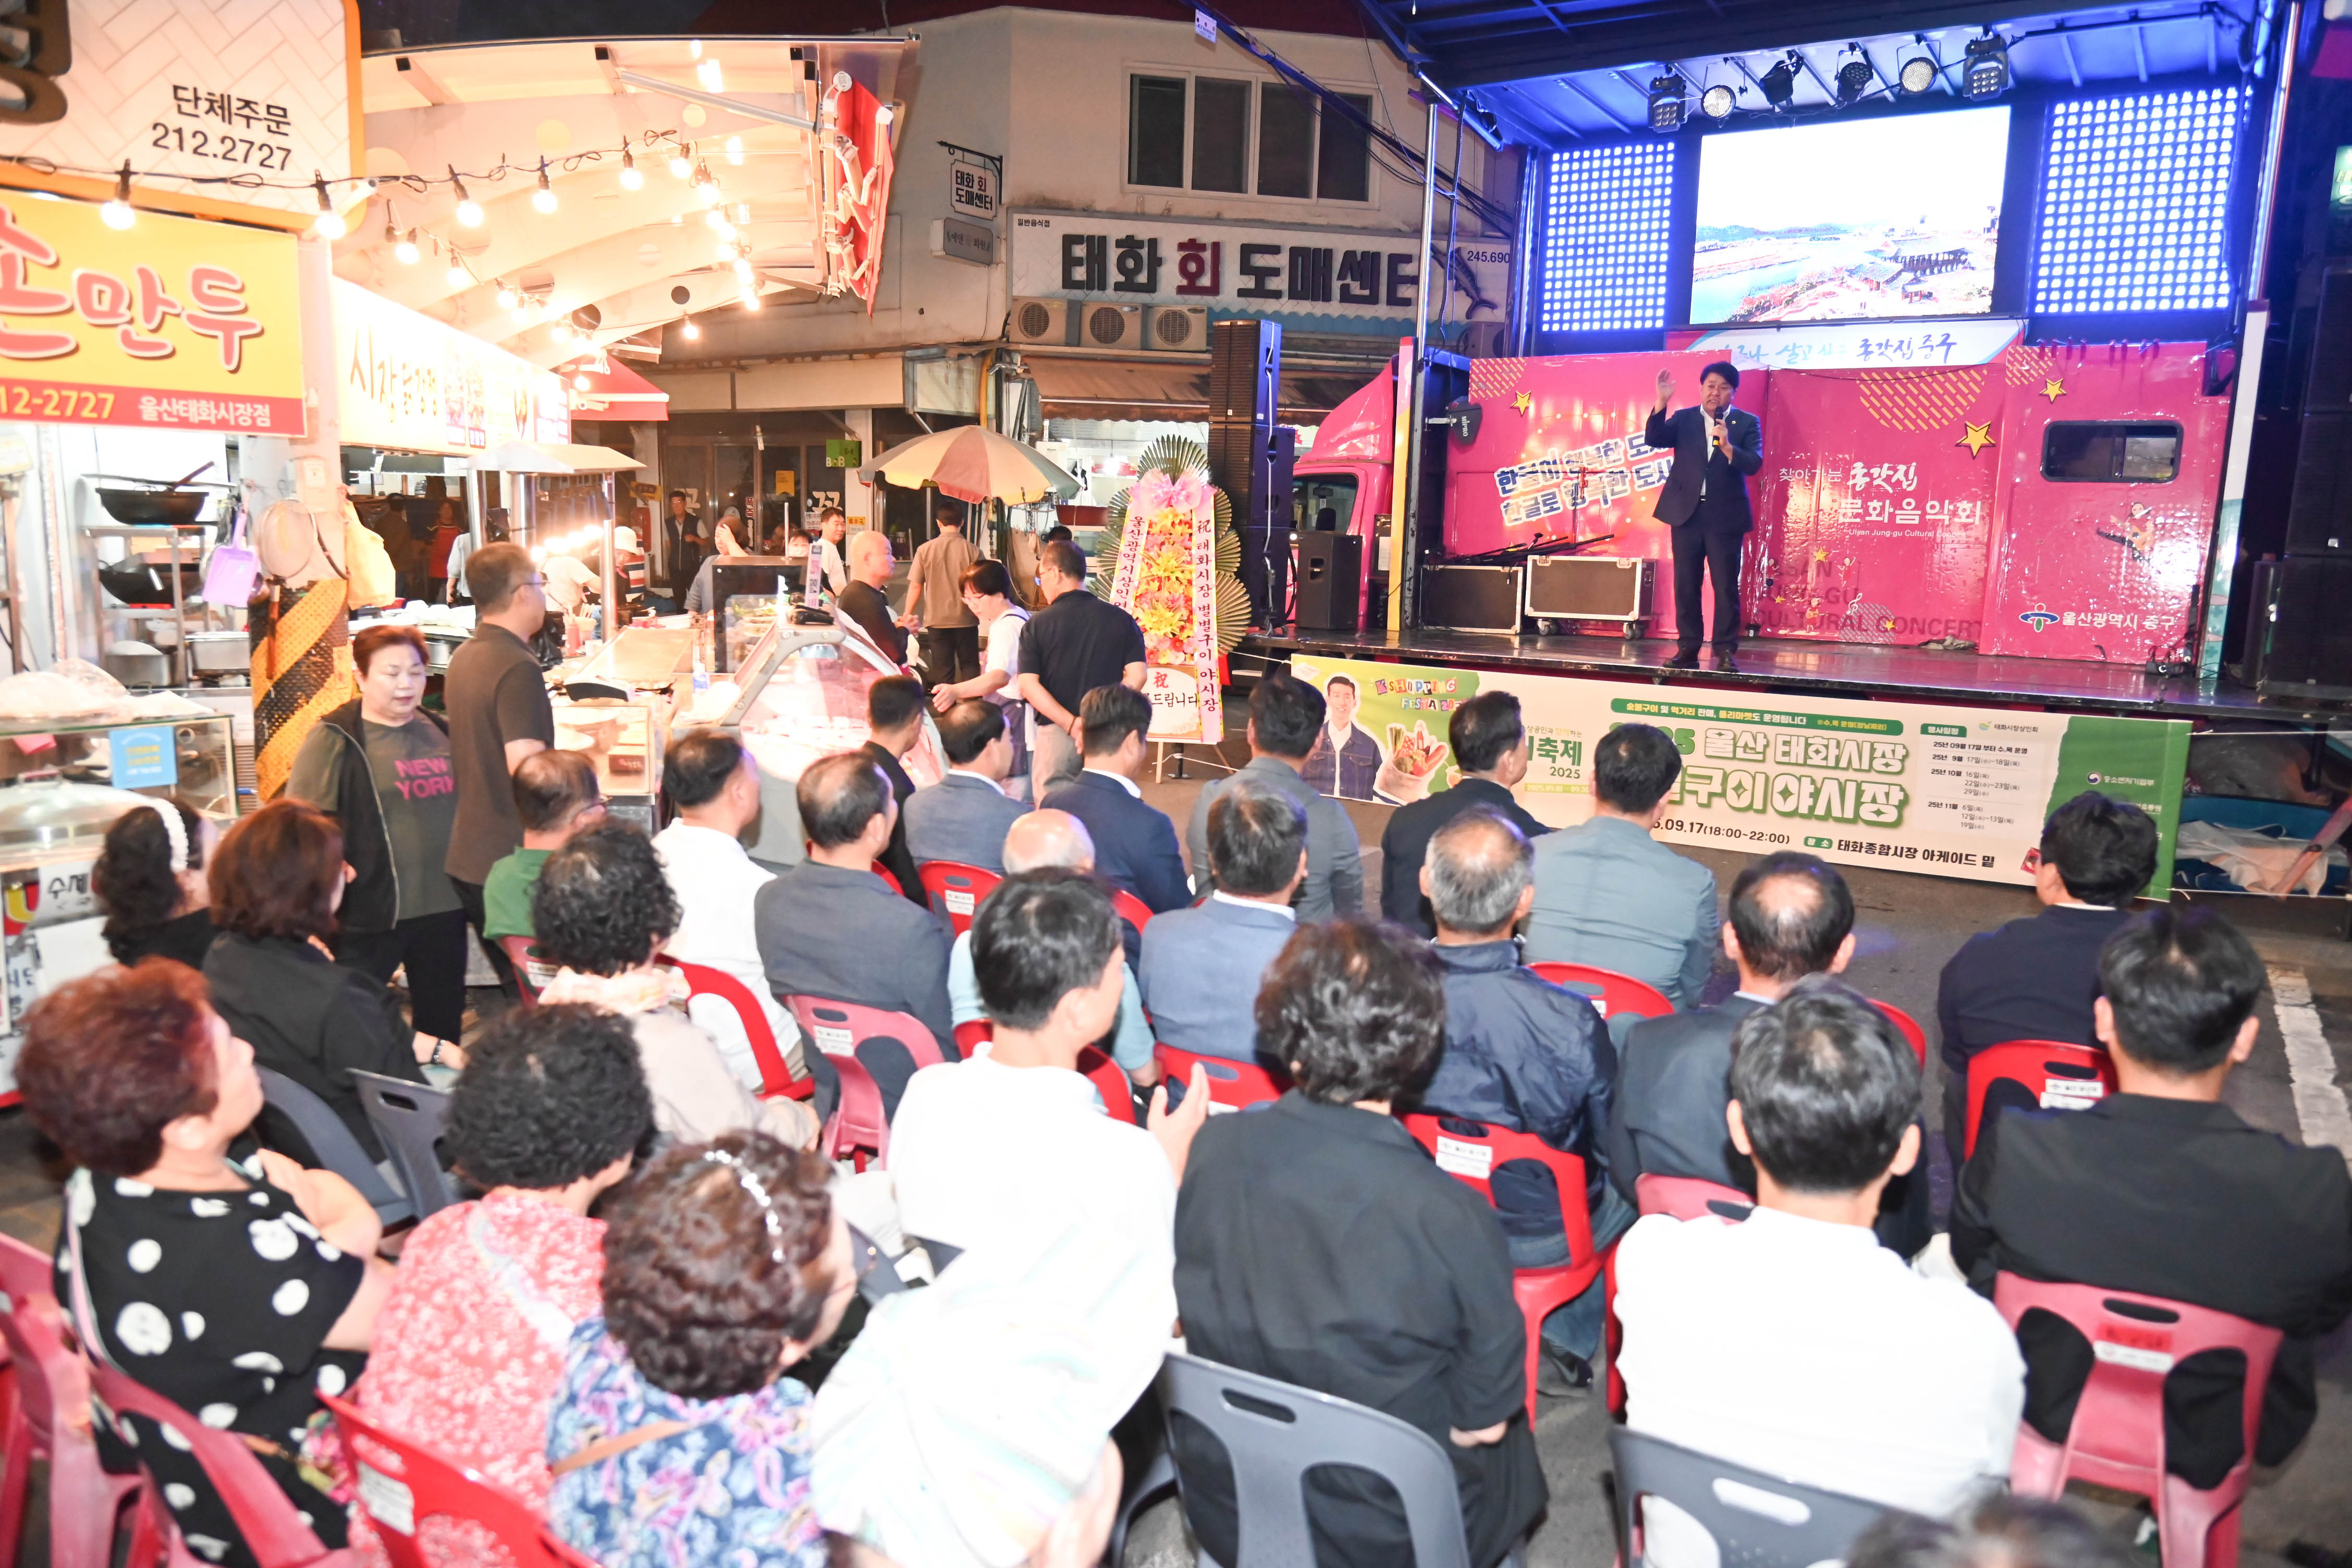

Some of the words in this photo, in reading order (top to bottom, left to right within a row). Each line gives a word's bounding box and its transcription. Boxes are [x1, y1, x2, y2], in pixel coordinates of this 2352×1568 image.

[172, 84, 292, 137] 단체주문
[151, 123, 293, 172] 212.2727
[955, 169, 975, 189] 태화
[977, 175, 987, 193] 회
[955, 188, 993, 211] 도매센터
[1017, 218, 1050, 228] 일반음식점
[1061, 234, 1163, 293] 태화
[1175, 238, 1221, 296] 회
[1918, 333, 1957, 364] 중구
[138, 395, 272, 427] 울산태화시장점
[1847, 461, 1918, 493] 종갓집
[1501, 490, 1562, 524] 한글로
[1838, 498, 1981, 525] 문화음악회
[1197, 519, 1211, 534] 祝
[1871, 530, 1903, 538] Jung-gu
[1196, 539, 1212, 598] 태화시장
[1197, 603, 1214, 662] 별별구이
[2062, 611, 2138, 631] 울산광역시
[2142, 615, 2176, 630] 중구
[1153, 671, 1169, 689] 祝
[1199, 668, 1218, 712] 야시장
[1401, 697, 1439, 711] FESTA
[1626, 702, 1659, 713] 숯불구이
[1660, 705, 1669, 714] 및
[1671, 705, 1696, 716] 먹거리
[1697, 708, 1717, 719] 판매,
[1719, 709, 1761, 721] 플리마켓도
[1762, 713, 1807, 725] 운영됩니다
[1522, 724, 1553, 734] 상공인과
[1927, 726, 1959, 736] 행사일정
[1994, 723, 2039, 733] 태화시장상인회
[1705, 728, 1769, 763] 울산
[1774, 733, 1909, 776] 태화시장
[395, 757, 449, 778] NEW
[1549, 766, 1581, 779] 2025
[1965, 771, 1990, 779] 16일(목)
[1771, 771, 1909, 828] 야시장
[1964, 788, 1989, 797] 29일(수)
[1962, 804, 1983, 813] 6일(목)
[1961, 822, 1985, 830] 19일(수)
[1838, 839, 1919, 859] 태화종합시장
[1922, 849, 1978, 866] 아케이드
[1981, 855, 1995, 868] 밑
